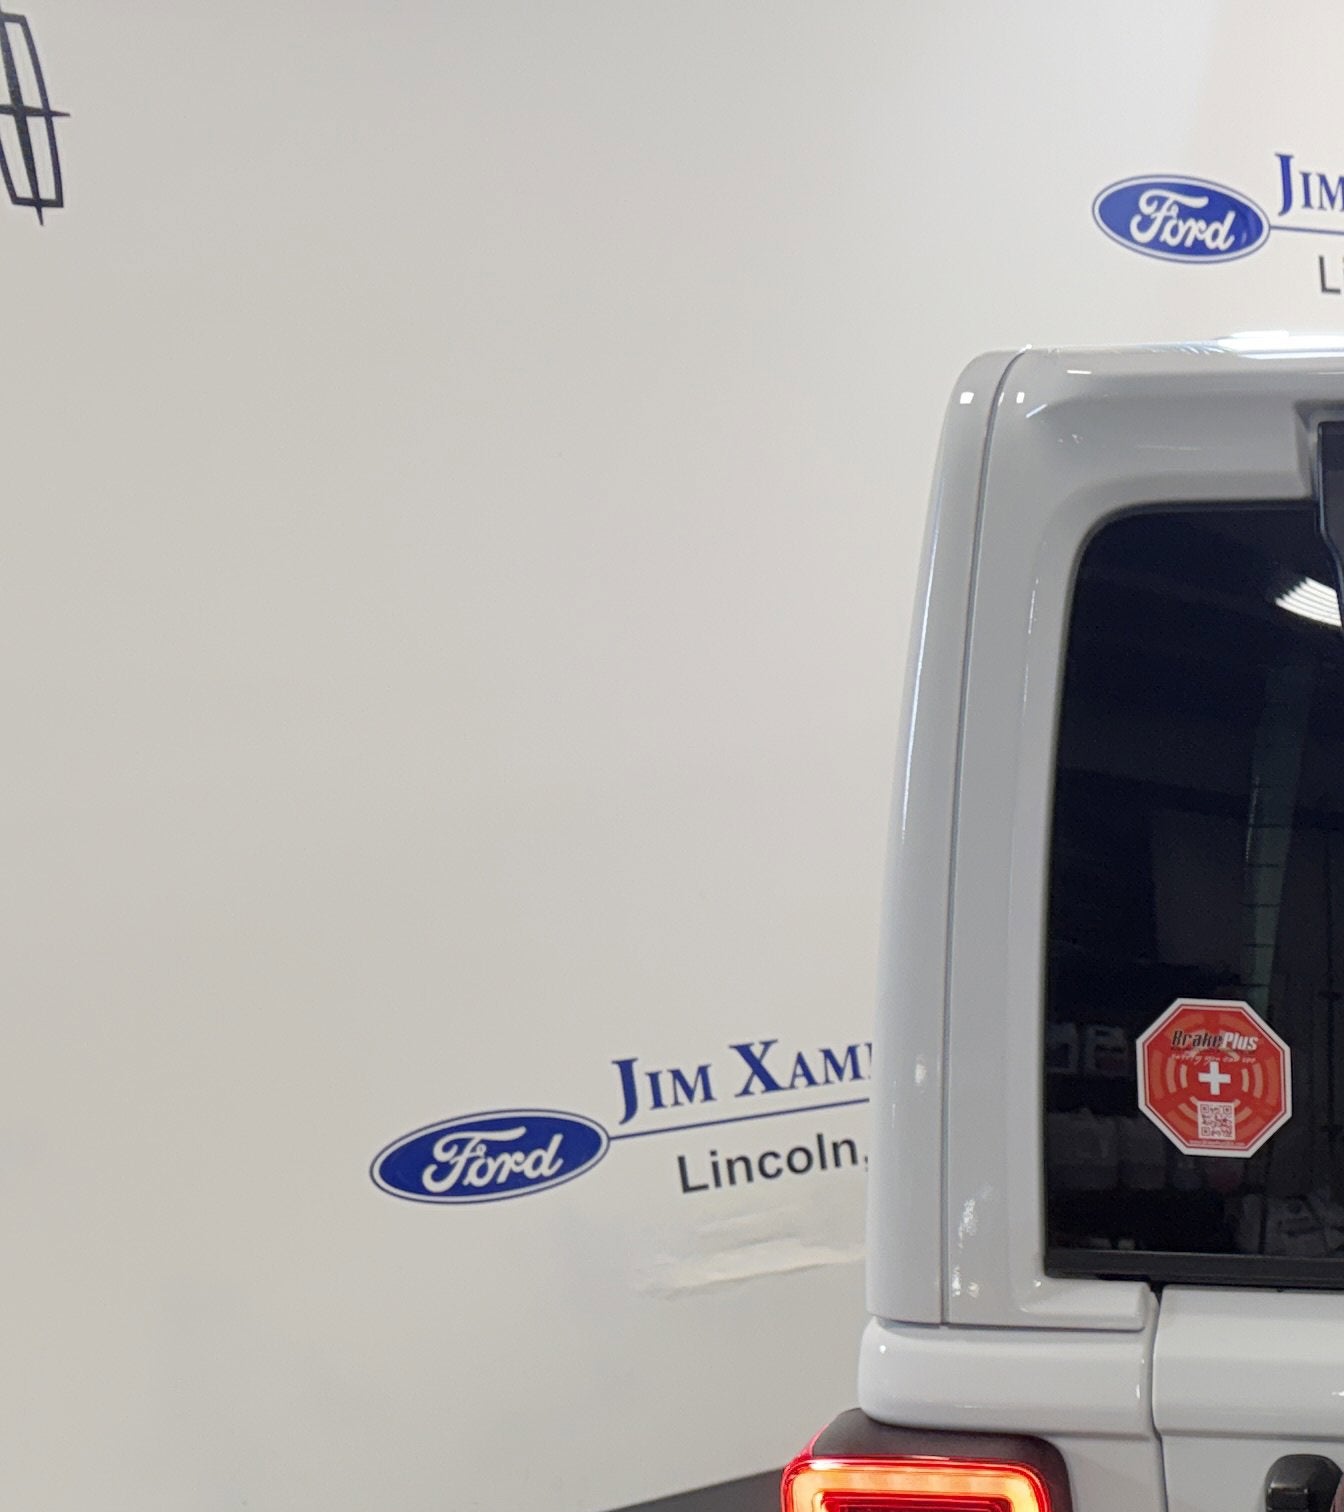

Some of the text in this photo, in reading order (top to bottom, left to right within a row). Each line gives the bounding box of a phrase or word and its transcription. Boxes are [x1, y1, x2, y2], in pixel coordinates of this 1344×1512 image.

[1130, 189, 1235, 250] Ford
[611, 1039, 873, 1126] JIM XAM
[421, 1126, 563, 1193] Ford
